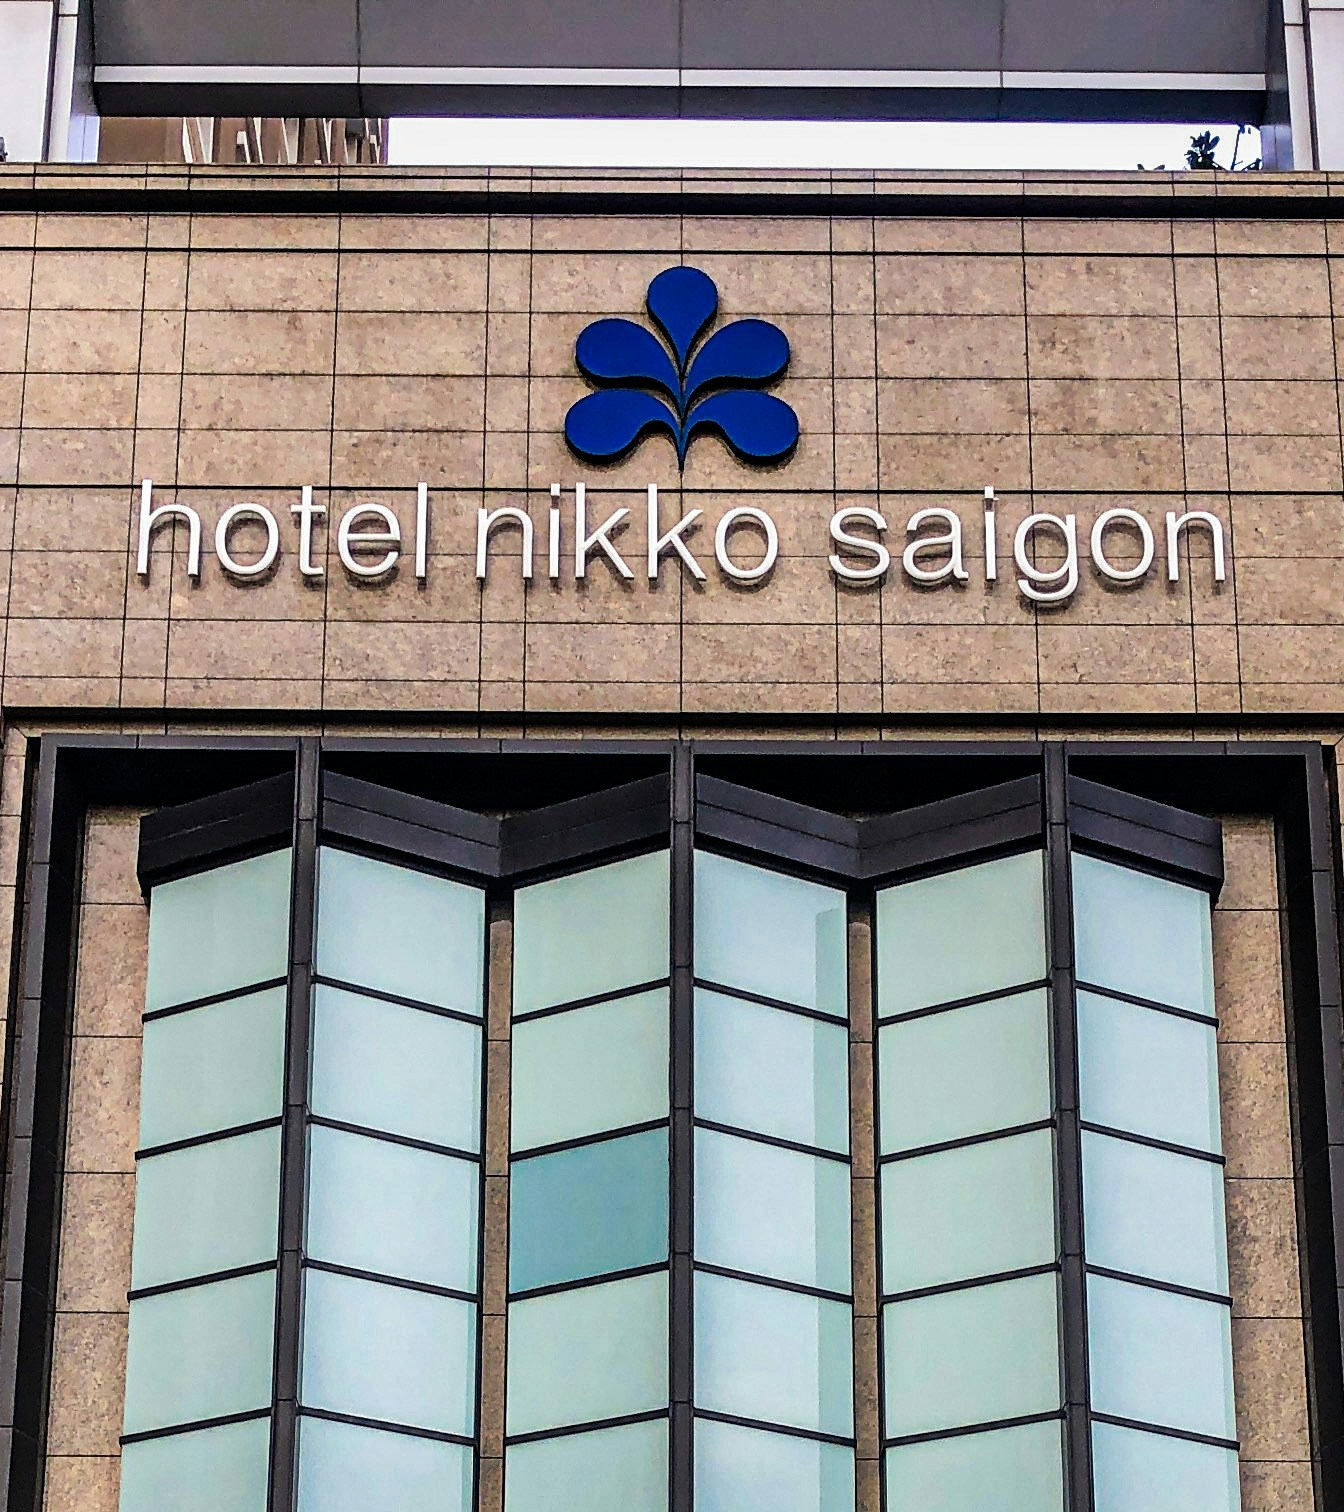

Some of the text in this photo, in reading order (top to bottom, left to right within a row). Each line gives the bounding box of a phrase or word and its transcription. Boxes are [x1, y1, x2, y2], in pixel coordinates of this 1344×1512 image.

[136, 478, 1227, 605] hotel nikko saigon
